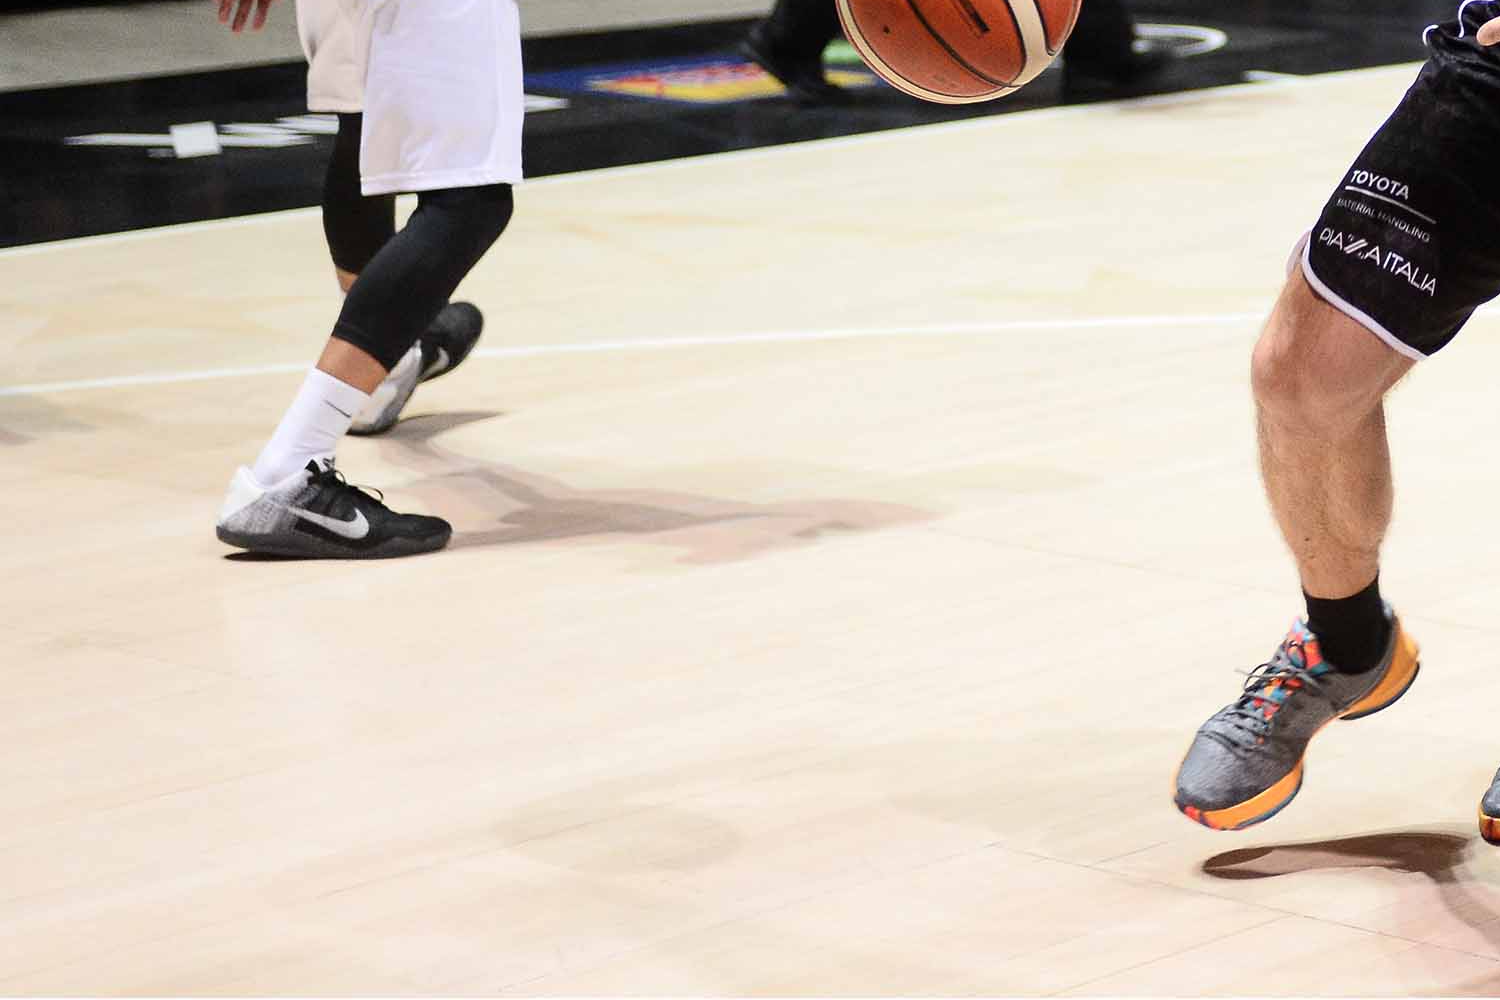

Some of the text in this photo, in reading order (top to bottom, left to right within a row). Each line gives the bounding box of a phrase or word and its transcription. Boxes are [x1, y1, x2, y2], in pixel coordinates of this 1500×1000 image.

[1350, 169, 1409, 200] TOYOTA
[1336, 198, 1376, 218] MATERIAL
[1383, 251, 1437, 297] ITALIA
